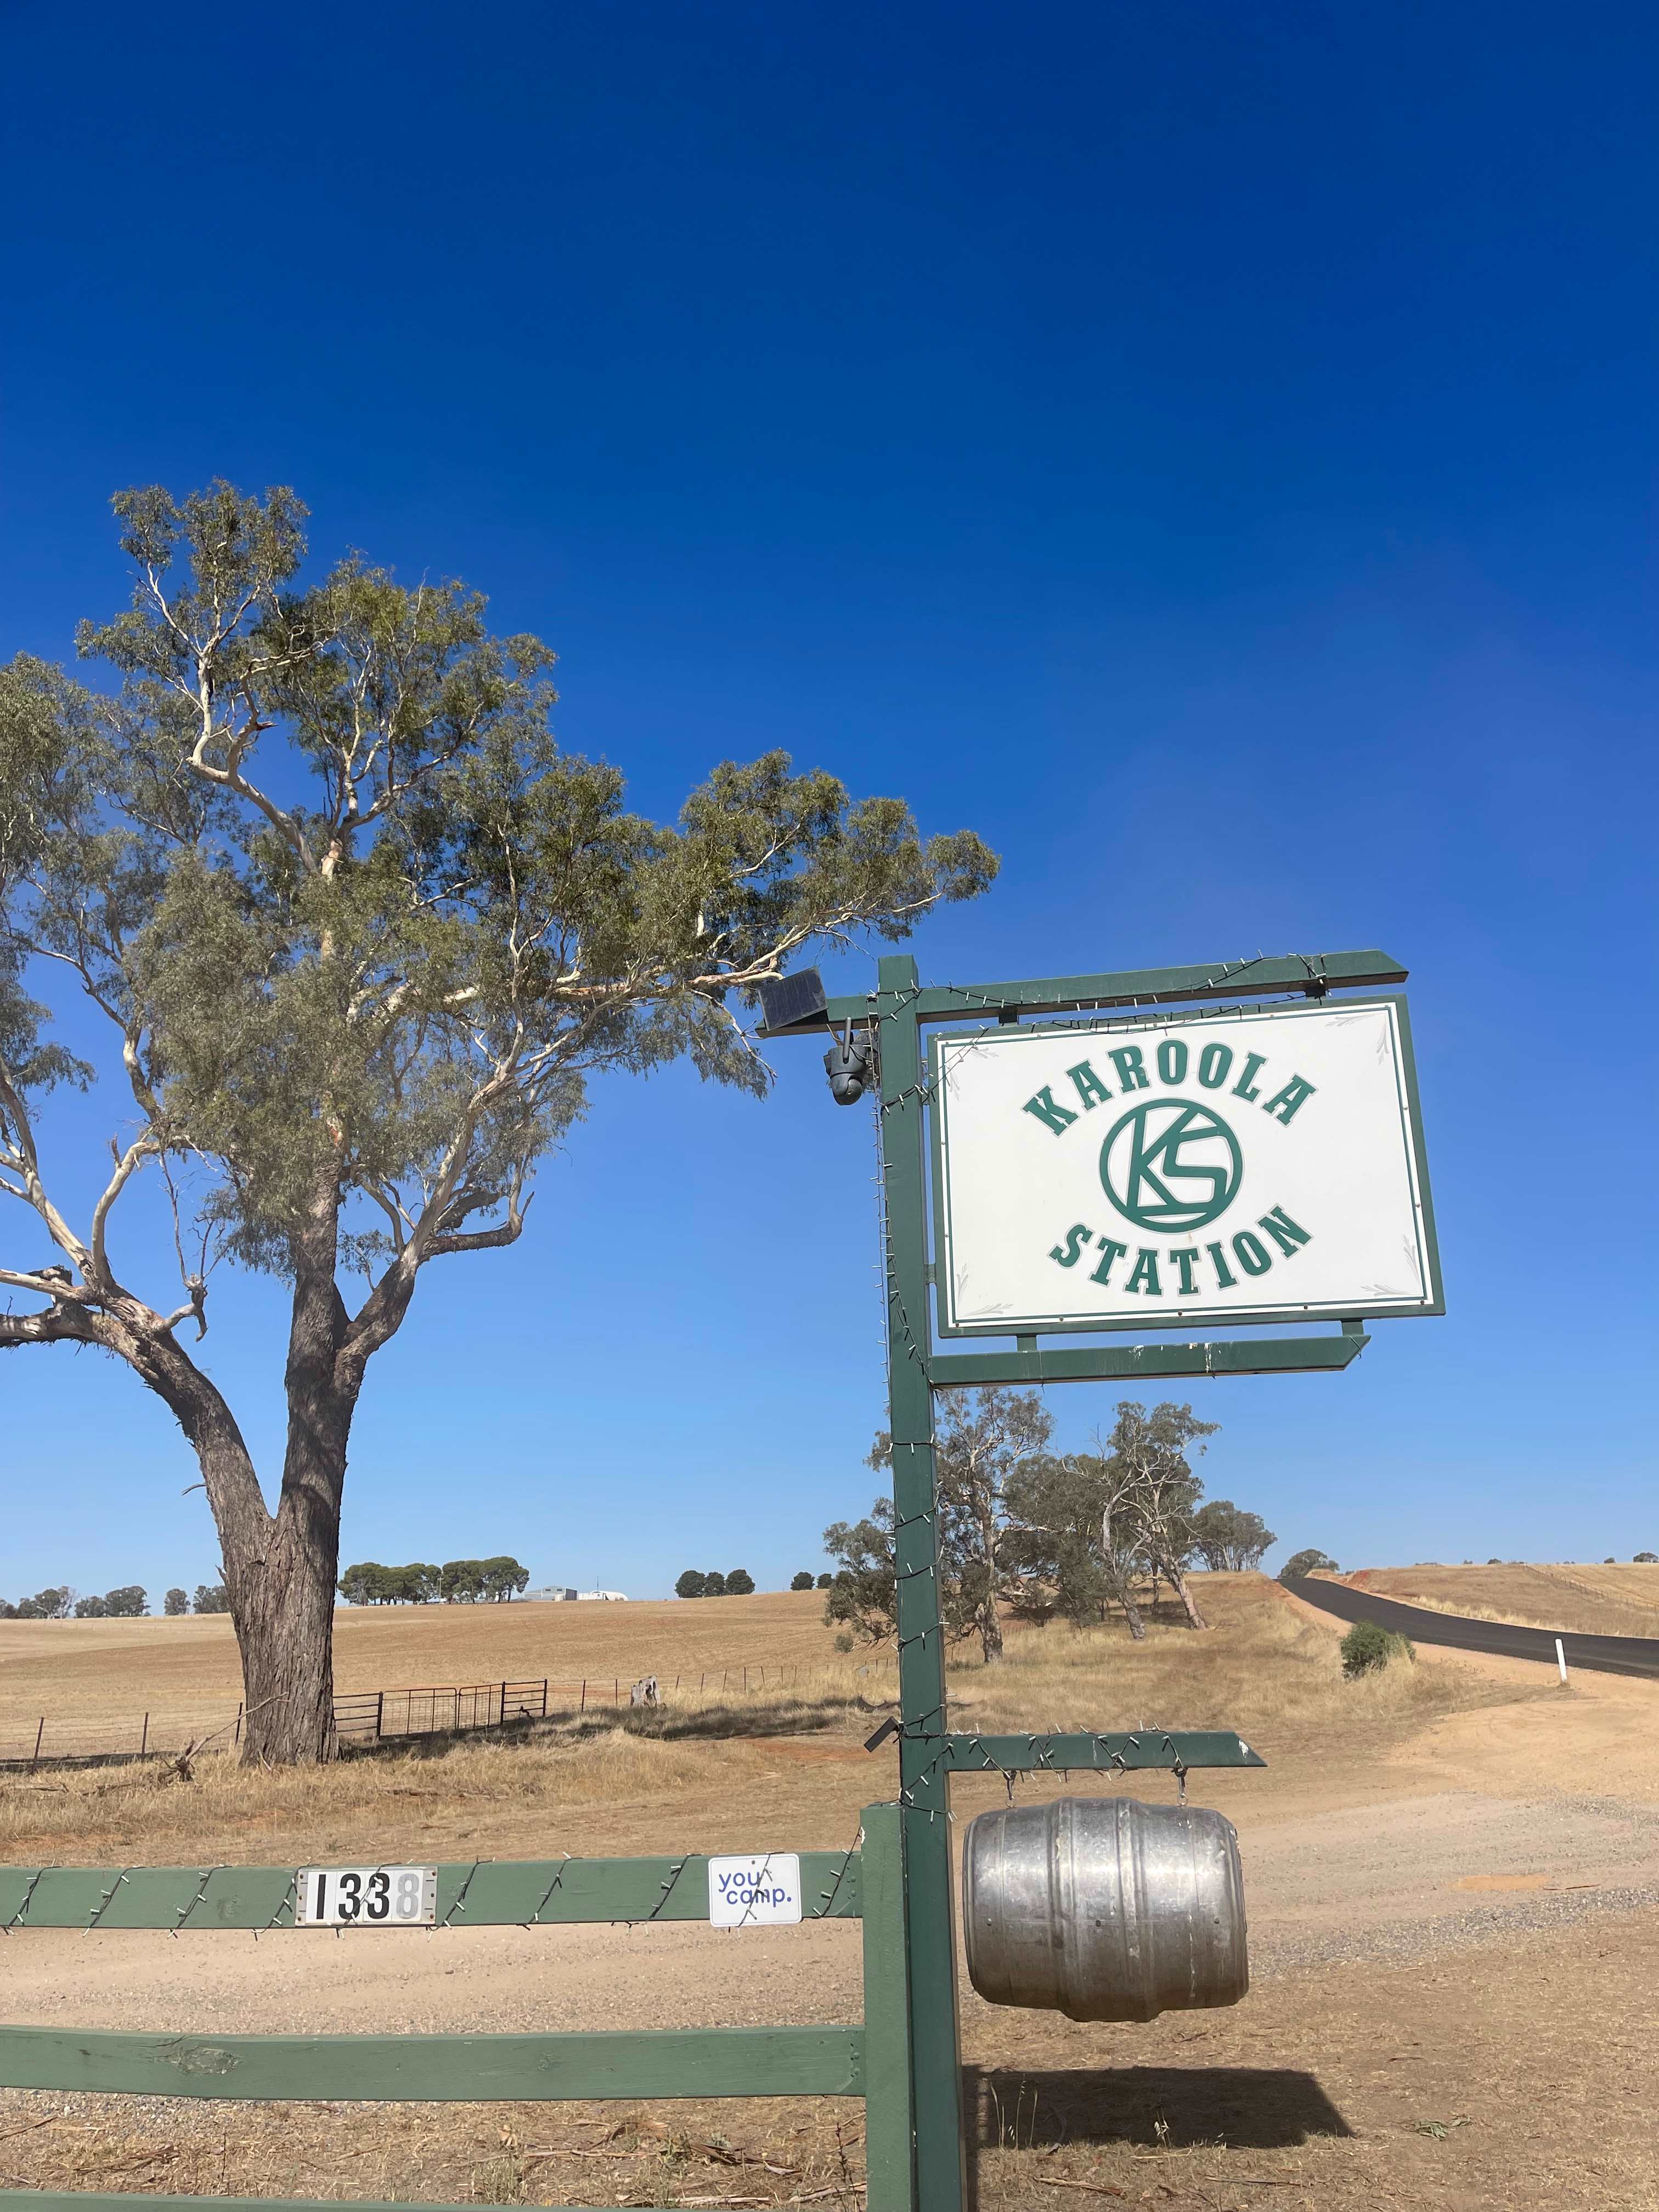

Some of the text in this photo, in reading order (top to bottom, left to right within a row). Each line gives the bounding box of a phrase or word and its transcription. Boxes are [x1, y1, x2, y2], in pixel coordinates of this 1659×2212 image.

[1023, 1040, 1317, 1136] KAROOLA
[1122, 1102, 1232, 1219] KS
[1049, 1204, 1313, 1295] STATION
[316, 1872, 419, 1920] 1338
[719, 1871, 760, 1892] you
[726, 1888, 792, 1908] camp.
